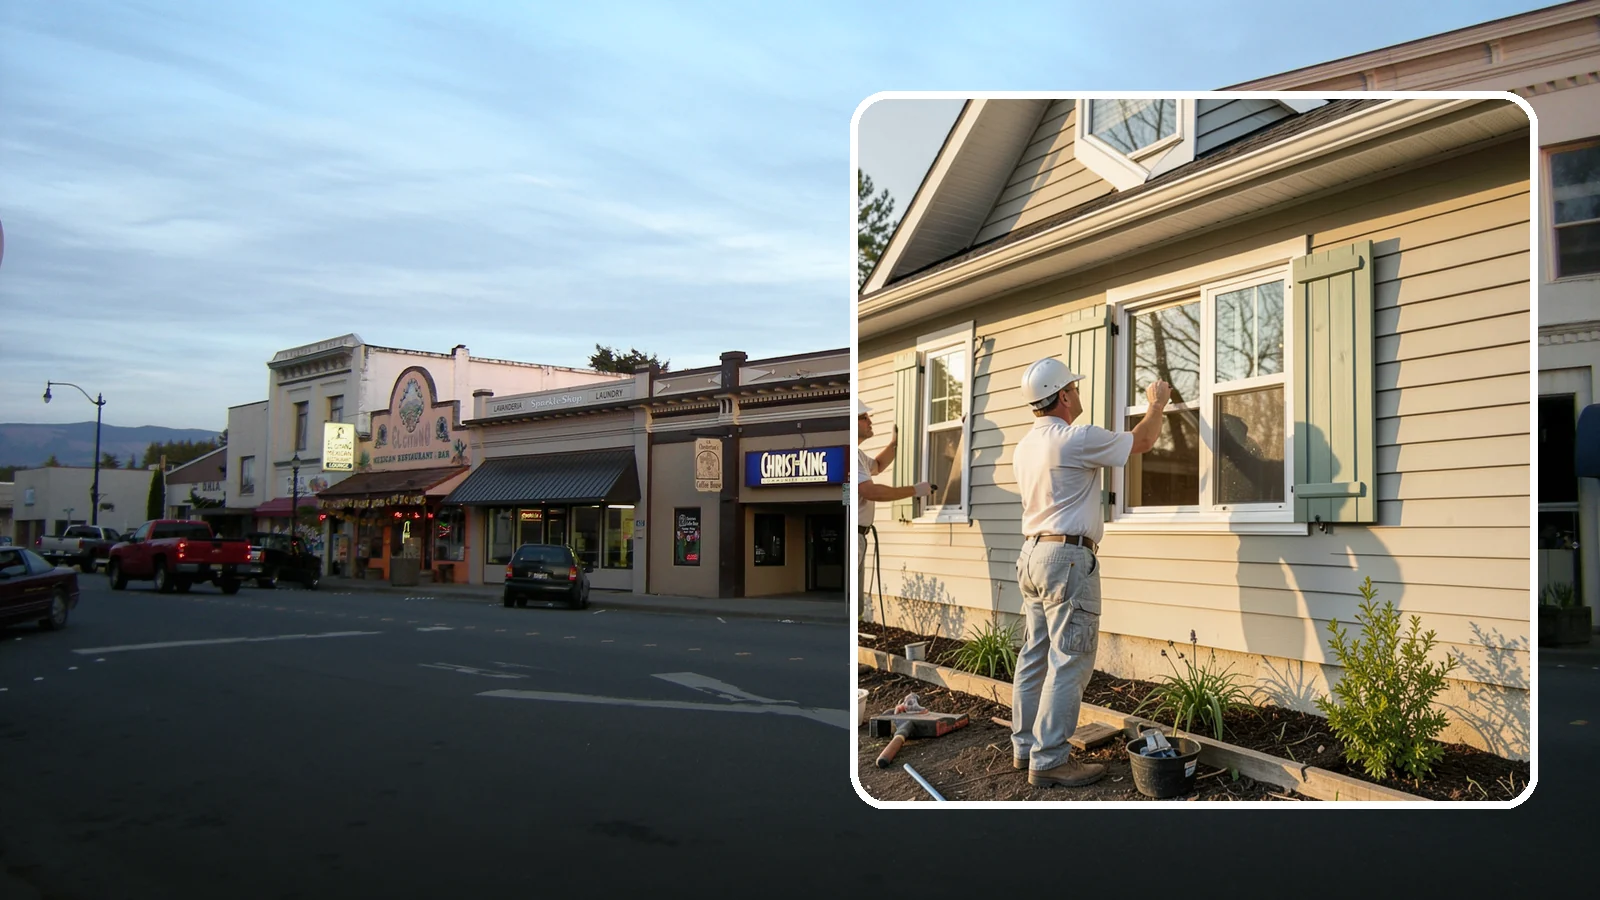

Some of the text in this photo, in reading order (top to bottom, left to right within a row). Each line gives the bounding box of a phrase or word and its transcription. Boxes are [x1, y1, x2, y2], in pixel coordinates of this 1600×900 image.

[530, 394, 583, 408] Sparkle Shop
[596, 389, 623, 400] LAUNDRY
[494, 402, 522, 412] LAVANDERIA
[392, 425, 402, 449] EL
[374, 455, 396, 464] MEXICAN
[397, 451, 433, 462] RESTAURANT
[437, 450, 450, 459] BAR
[760, 450, 827, 478] CHRIST KING
